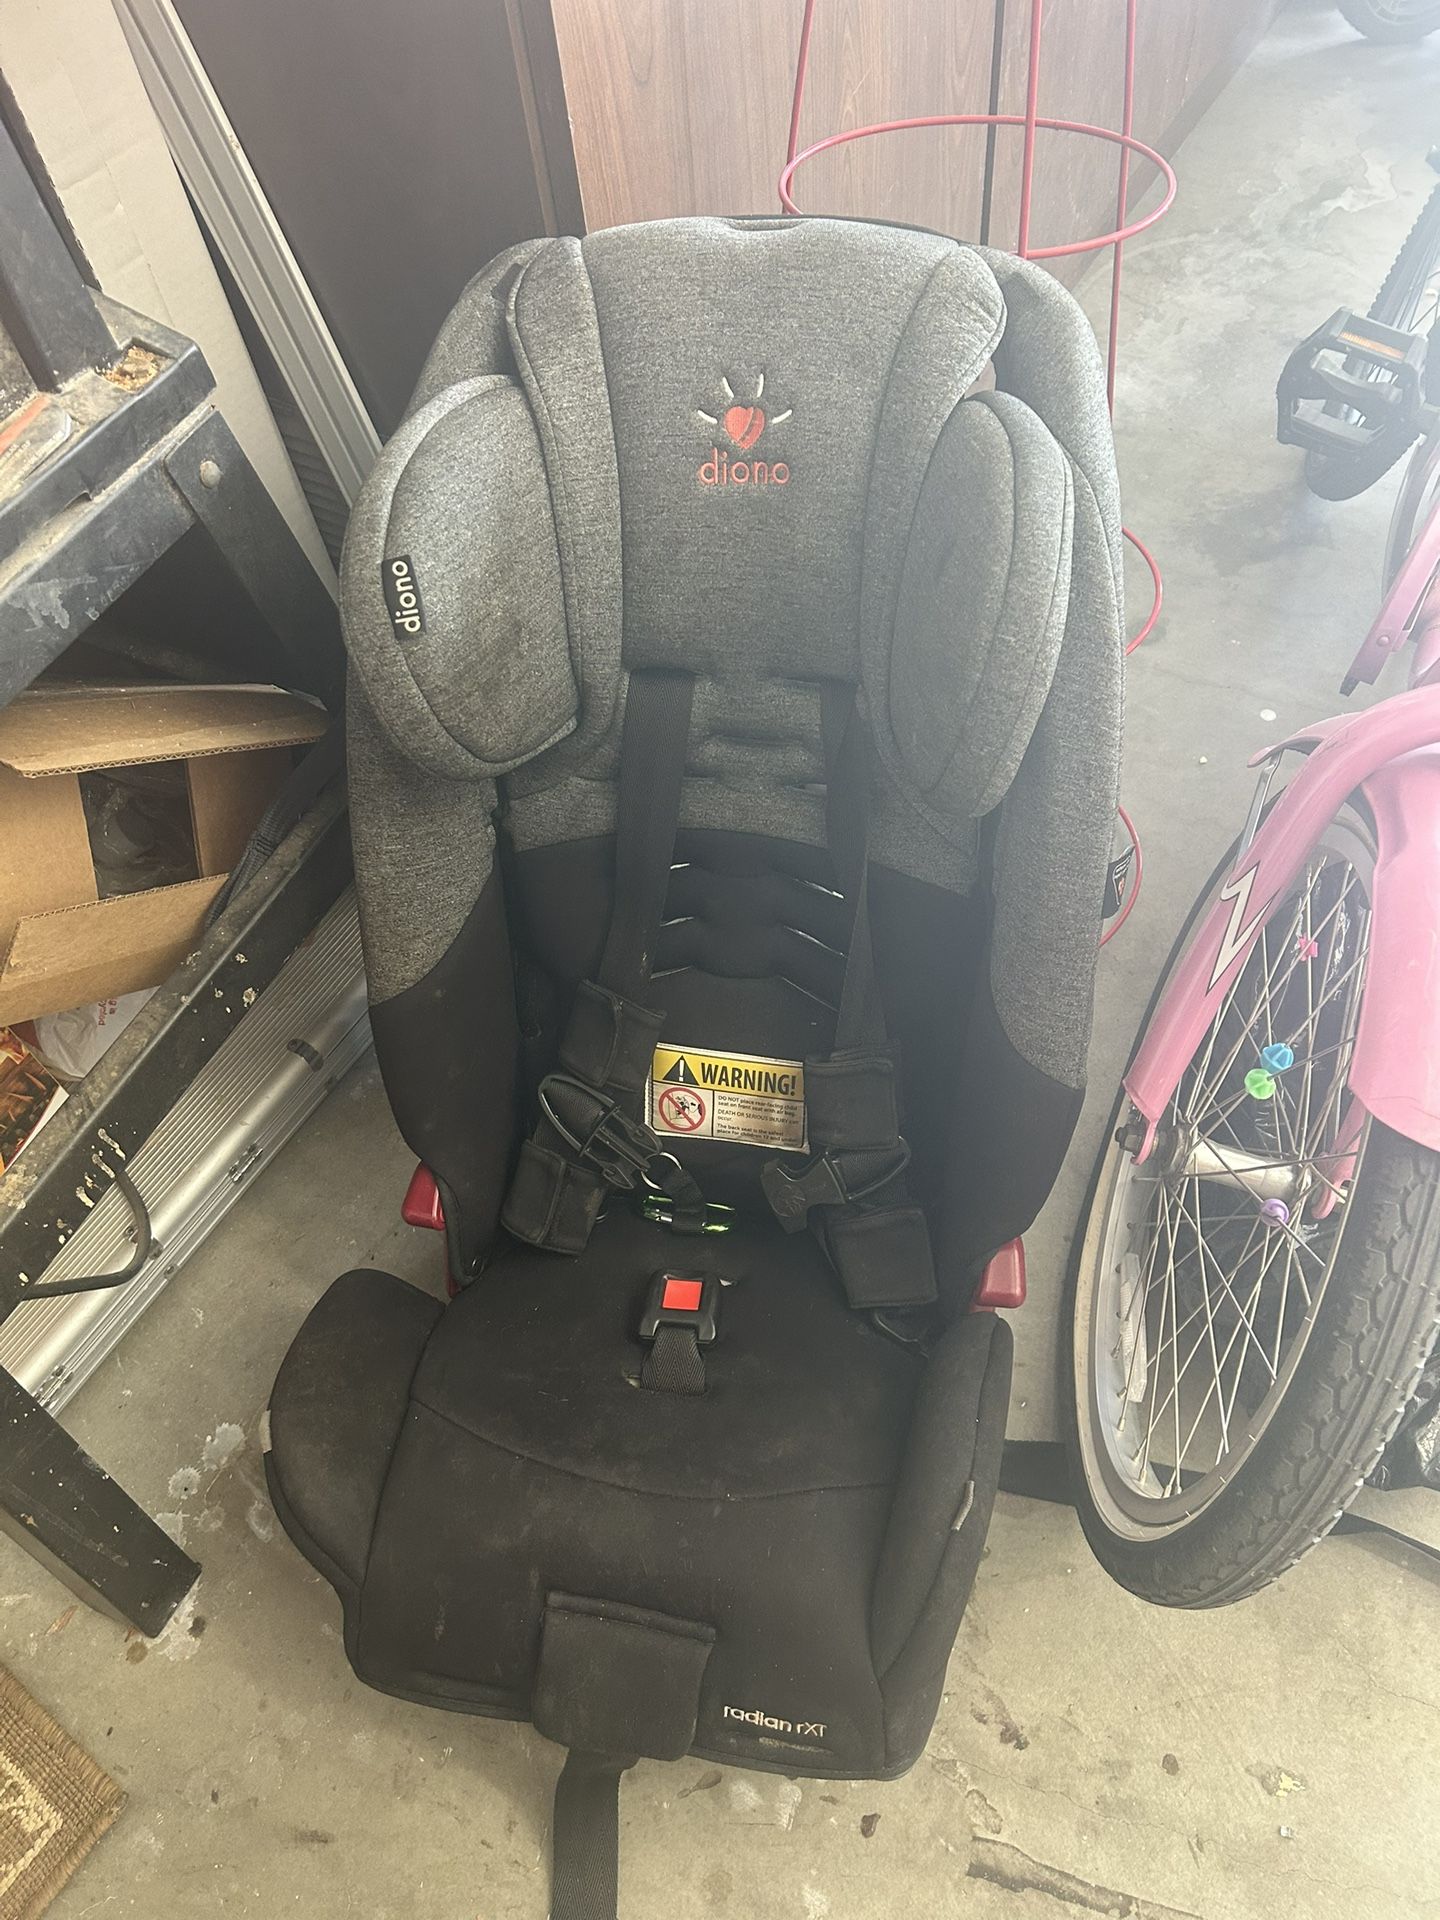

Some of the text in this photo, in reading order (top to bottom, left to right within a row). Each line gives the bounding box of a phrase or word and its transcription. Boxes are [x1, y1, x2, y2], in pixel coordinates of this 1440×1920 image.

[697, 447, 790, 484] diono
[391, 560, 421, 633] diono
[701, 1062, 796, 1096] WARNING!
[745, 1112, 769, 1121] SERIOUS
[769, 1115, 788, 1123] INJURY
[755, 1100, 784, 1111] rear-facing
[716, 1128, 731, 1136] place
[740, 1131, 762, 1139] children
[723, 1705, 828, 1738] radian rXT
